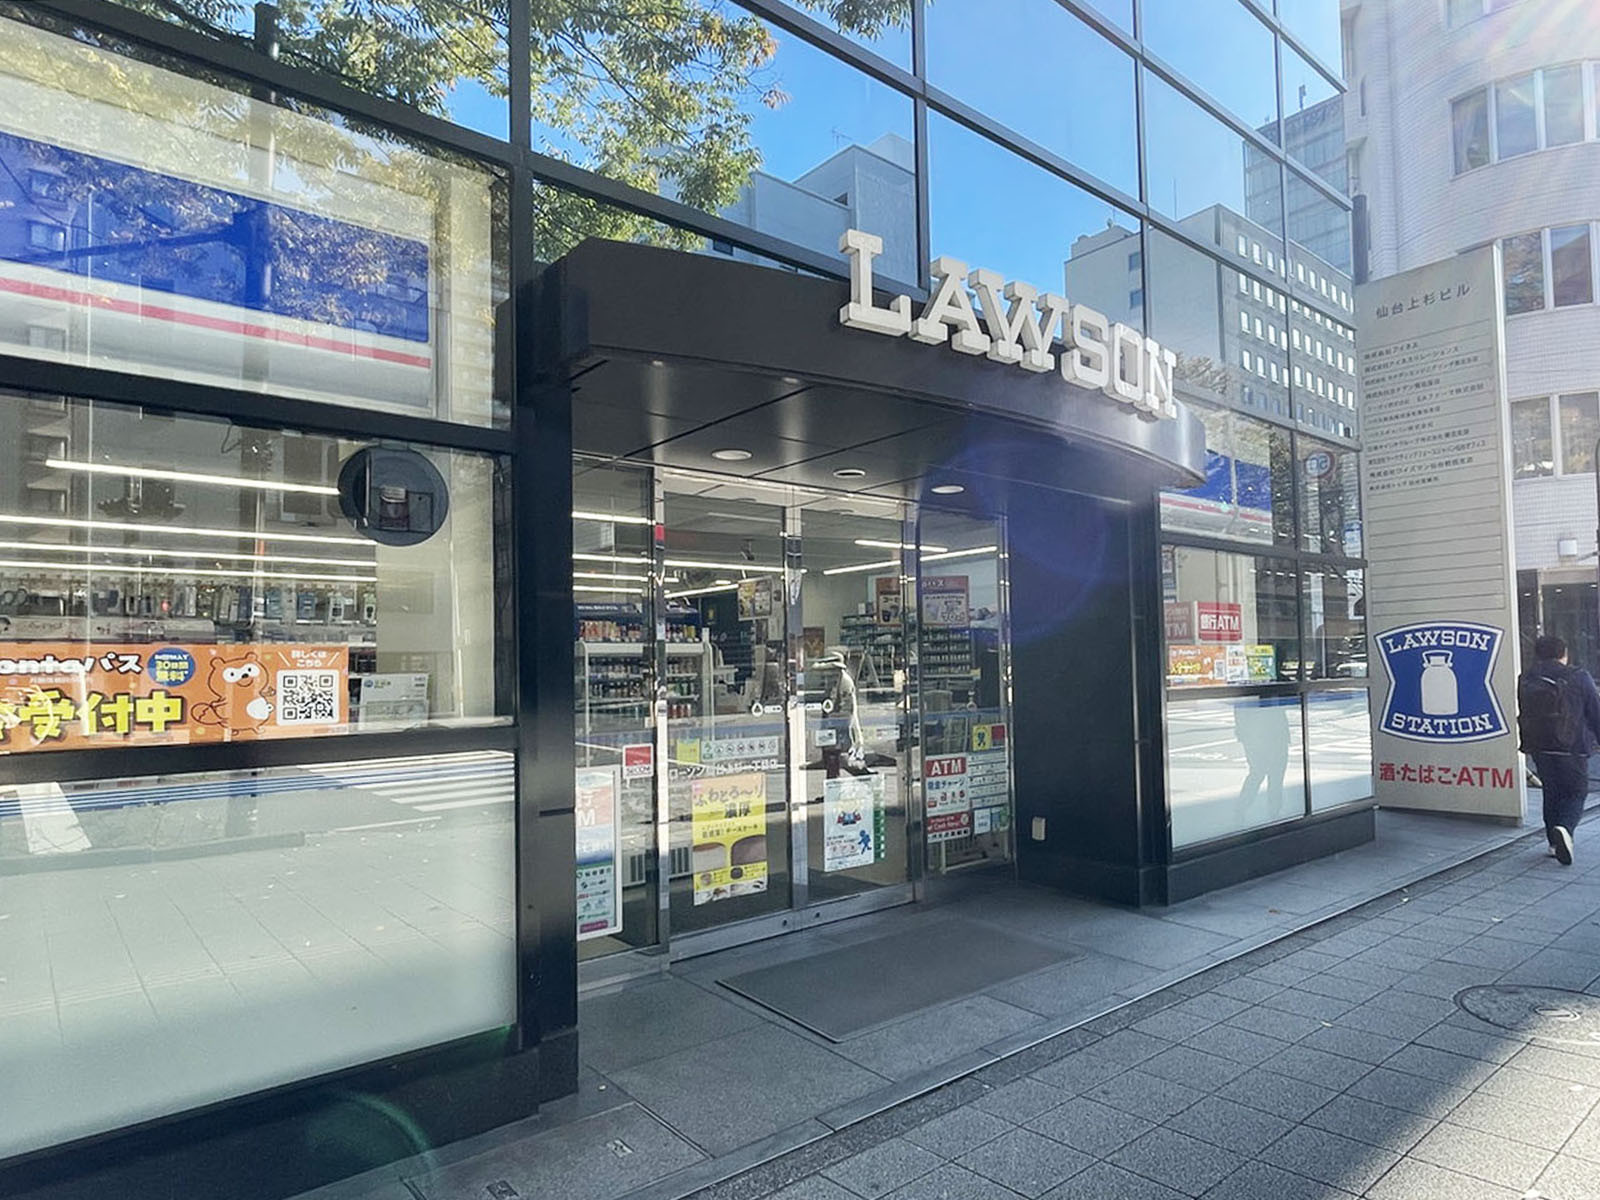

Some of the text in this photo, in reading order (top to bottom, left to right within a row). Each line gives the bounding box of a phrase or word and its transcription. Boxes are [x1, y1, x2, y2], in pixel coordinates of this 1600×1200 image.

[1375, 283, 1470, 319] 仙台上杉ビル
[838, 228, 1178, 419] LAWSON
[1386, 630, 1491, 654] LAWSON
[1391, 712, 1494, 735] STATION
[931, 759, 962, 776] ATM
